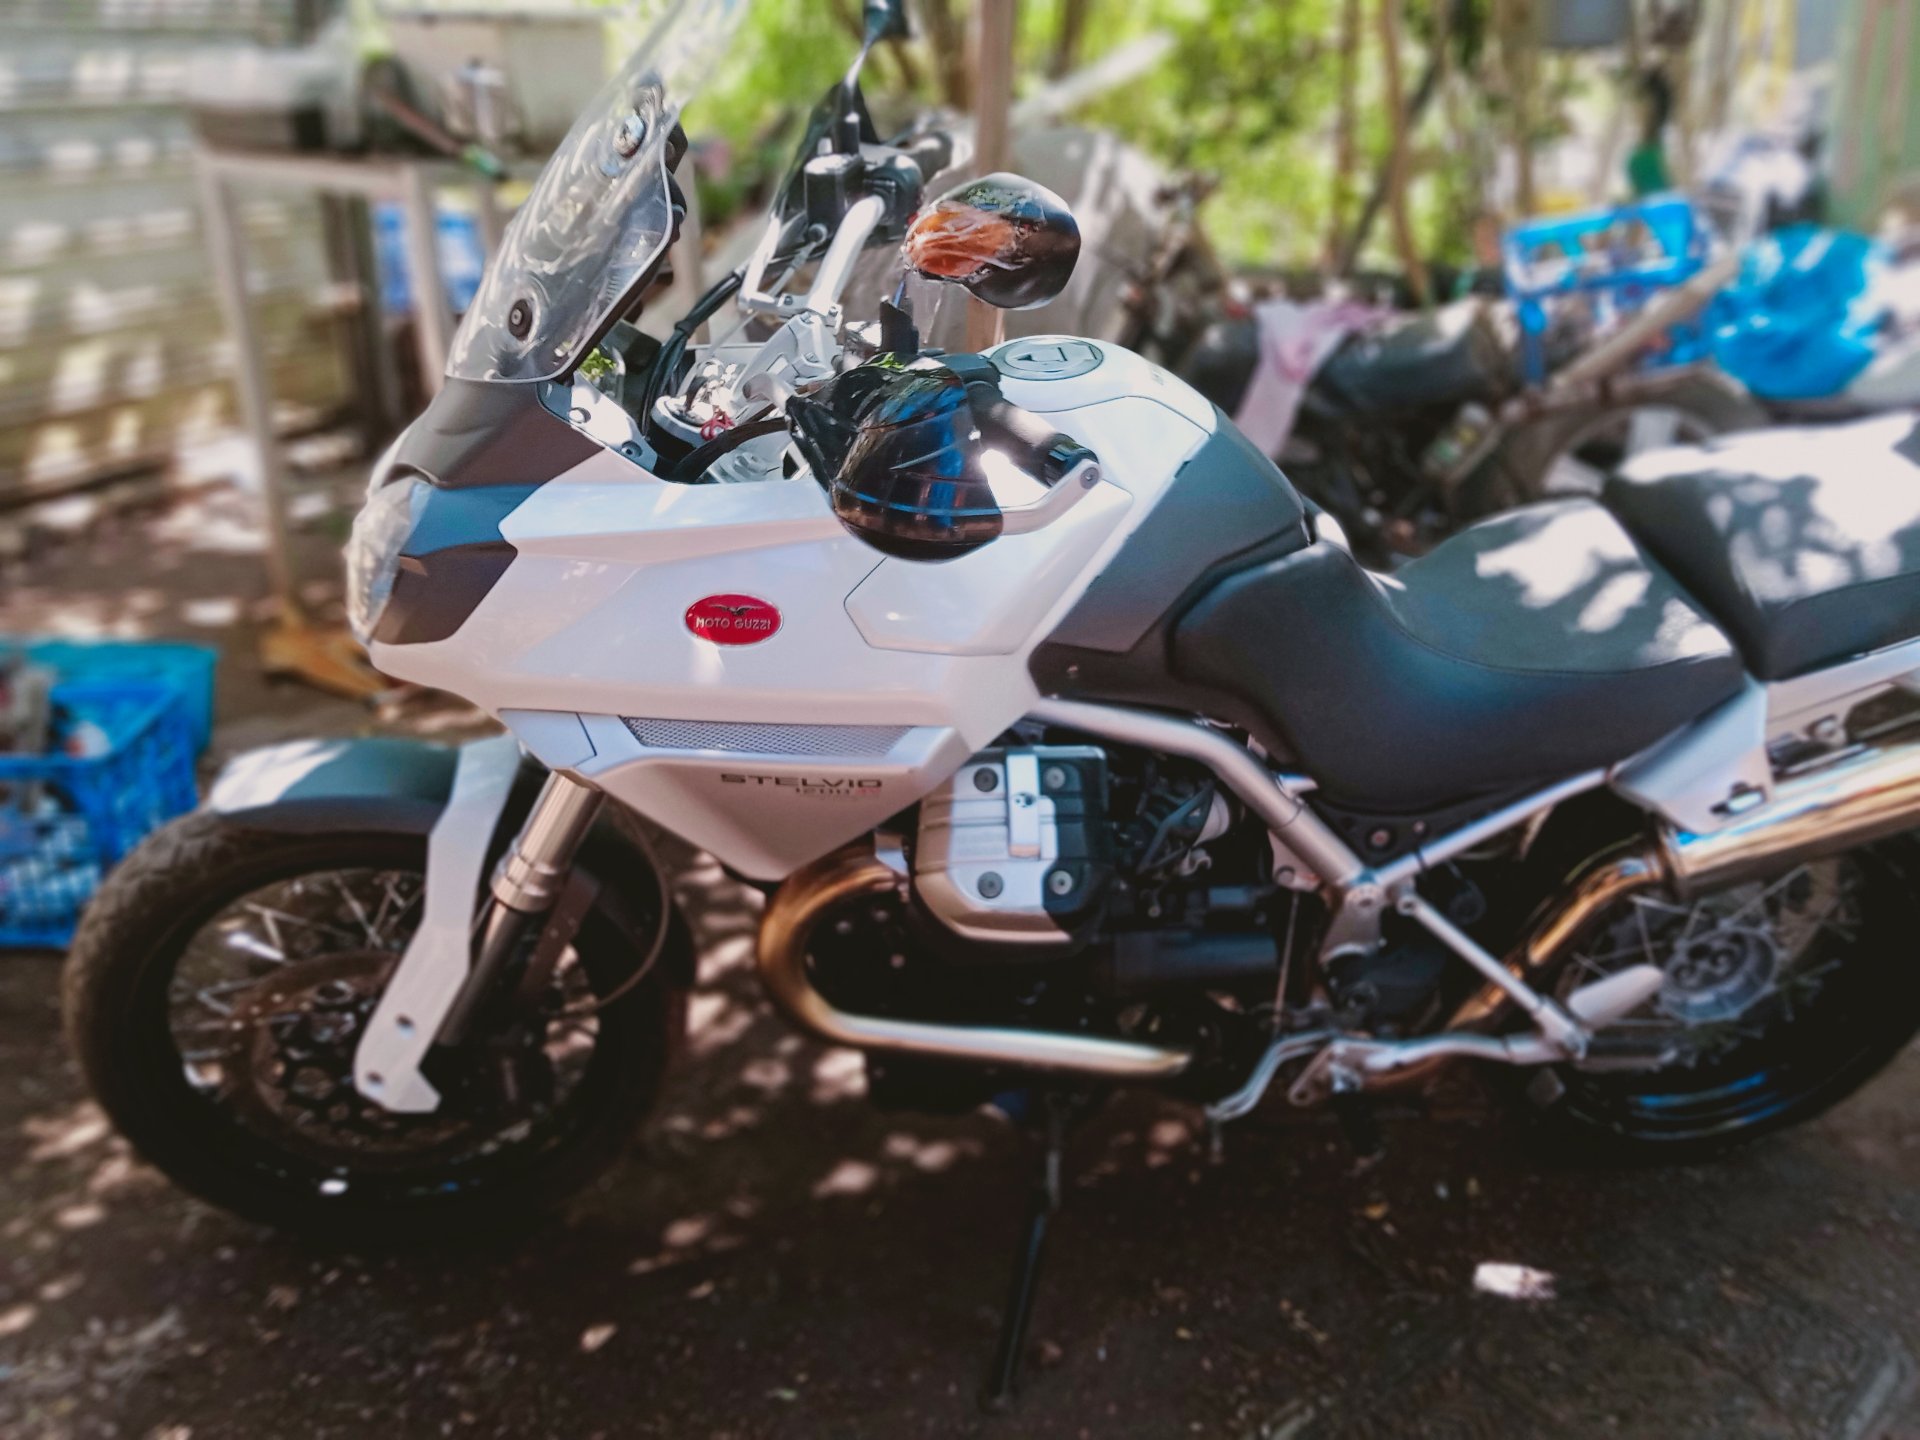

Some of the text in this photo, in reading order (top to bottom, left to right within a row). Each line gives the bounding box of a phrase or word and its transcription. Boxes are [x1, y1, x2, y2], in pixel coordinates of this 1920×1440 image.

[696, 616, 771, 630] MOTO GUZZI
[721, 773, 882, 788] STELVIO
